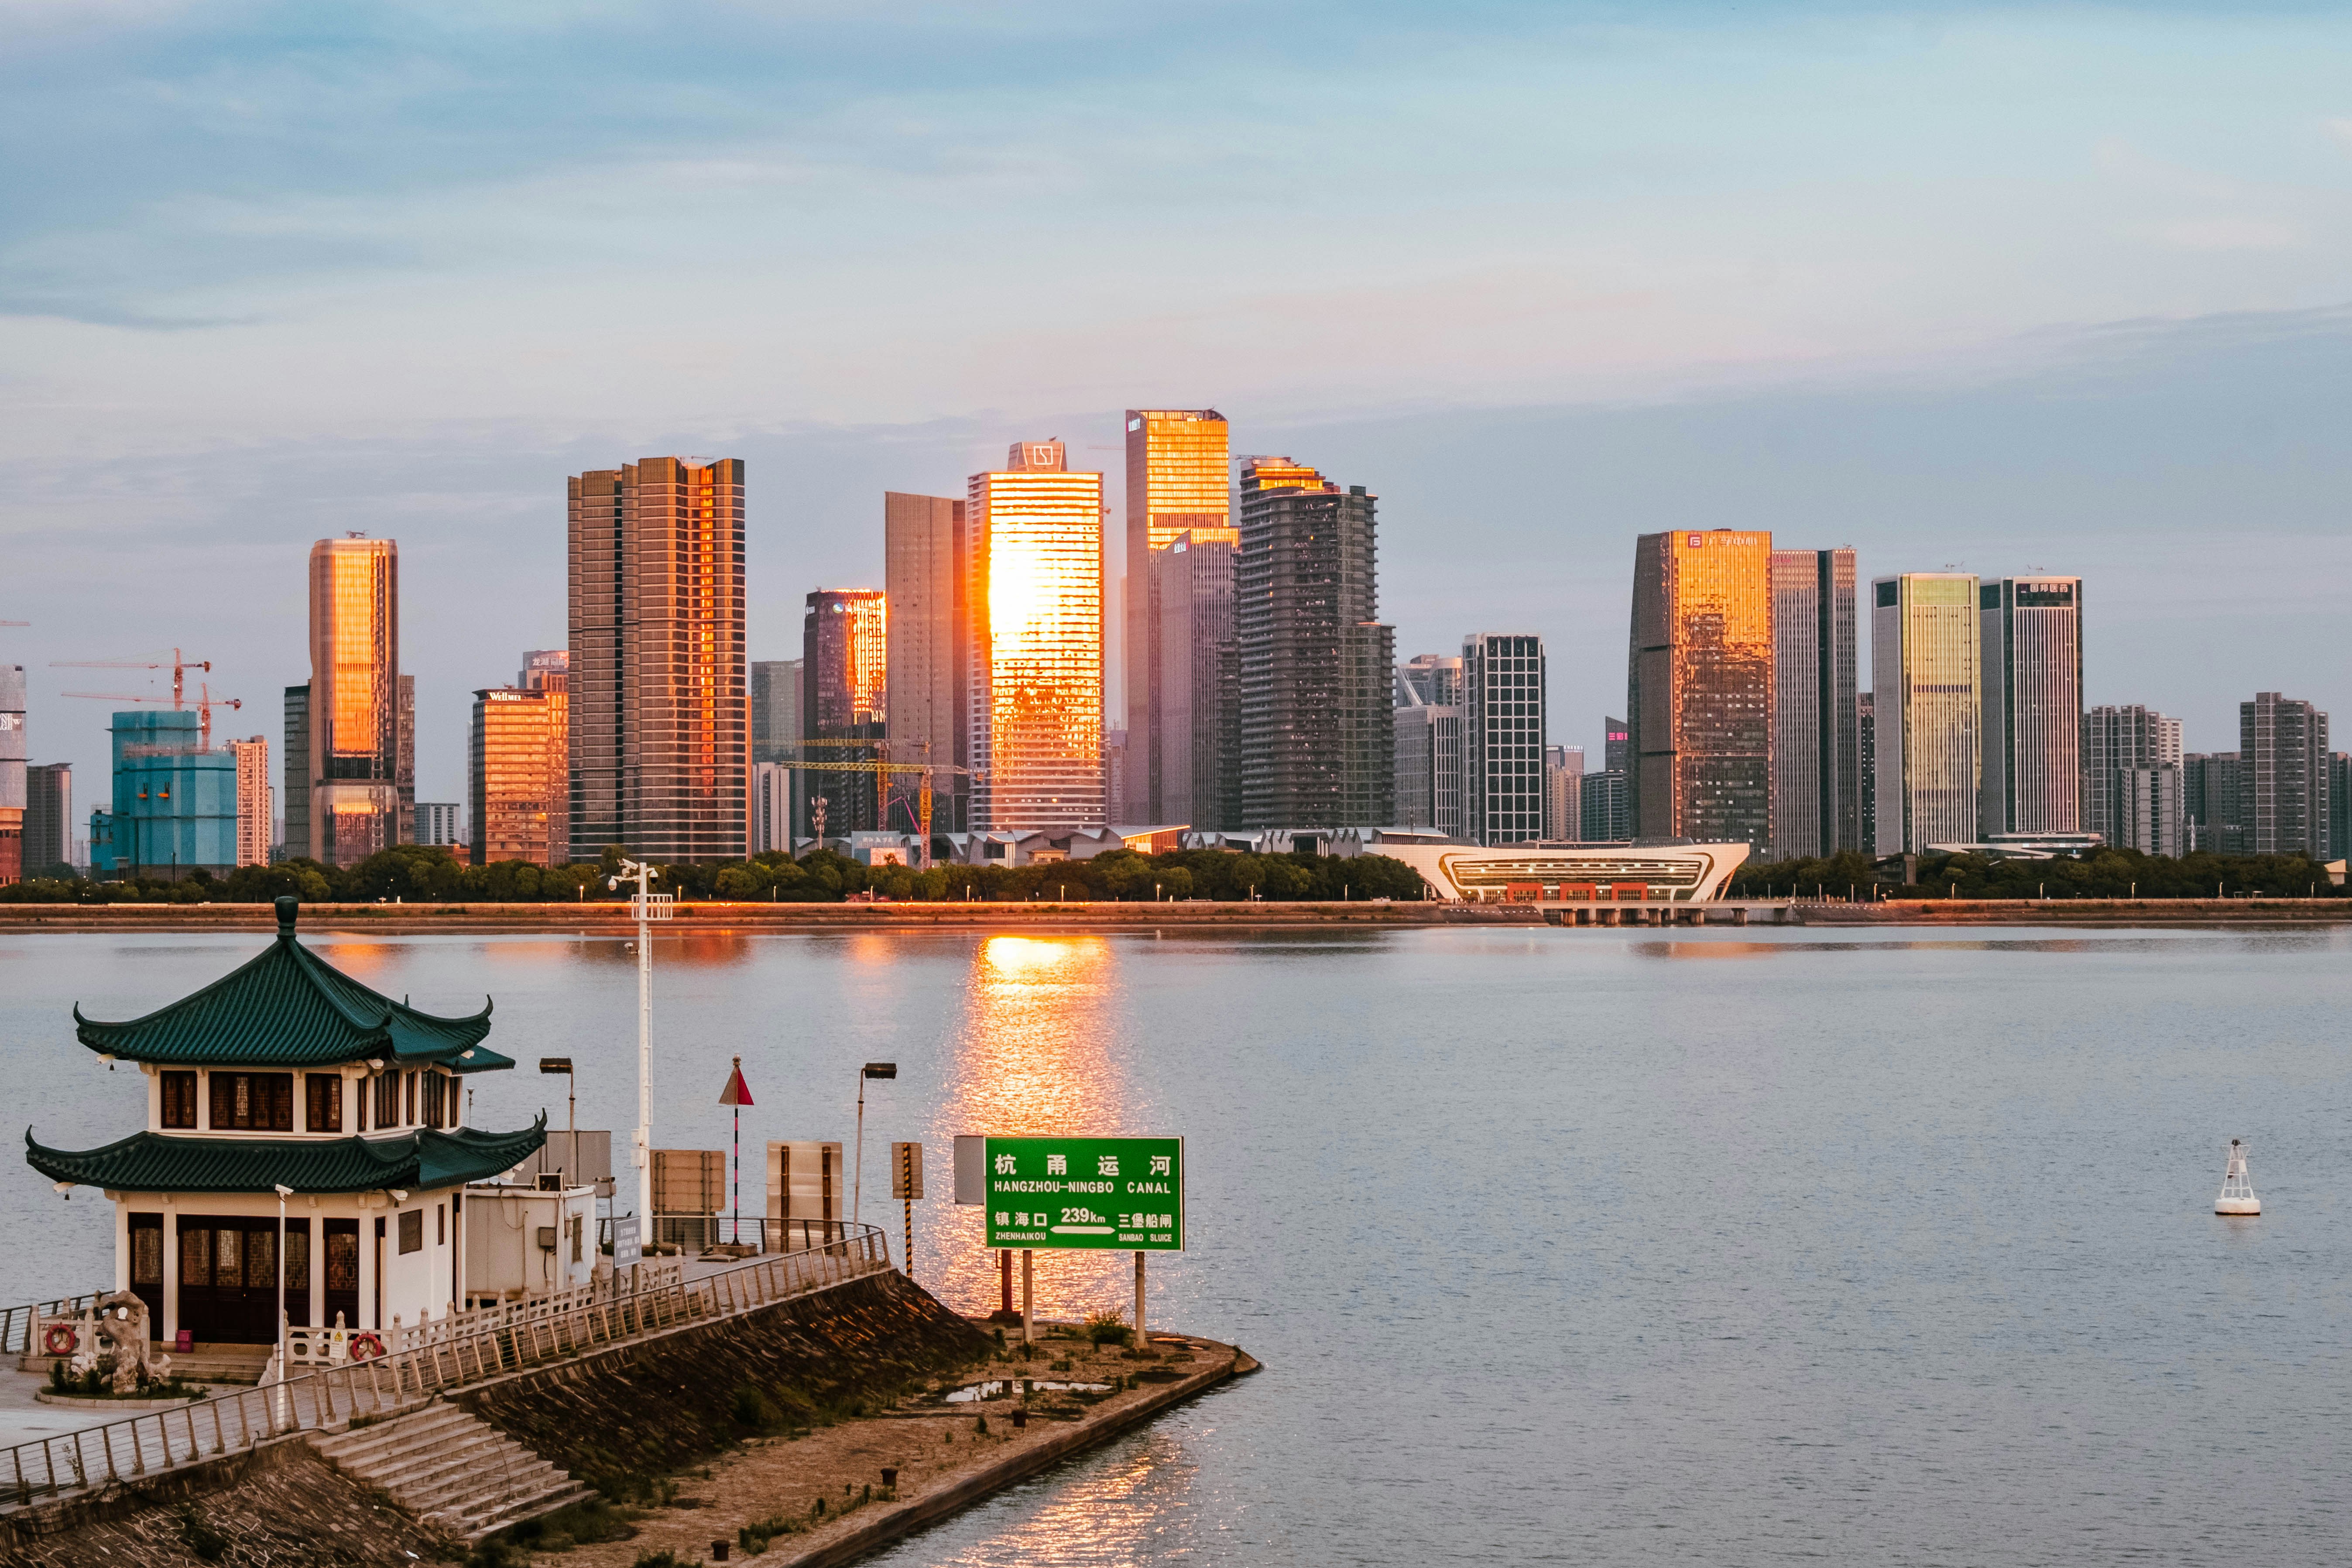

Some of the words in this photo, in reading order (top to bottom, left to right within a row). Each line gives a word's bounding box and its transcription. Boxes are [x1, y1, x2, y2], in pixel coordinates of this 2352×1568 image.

[2030, 583, 2068, 593] 国邦医药
[994, 1153, 1171, 1176] 杭甬运河
[994, 1180, 1114, 1194] HANGZHOU-NINGBO
[1127, 1181, 1171, 1194] CANAL
[994, 1211, 1047, 1227] 镇海口
[1118, 1212, 1172, 1228] 三堡船闸
[995, 1232, 1047, 1241] ZHENHAIKOU
[1118, 1233, 1144, 1242] SANBAO
[1149, 1233, 1173, 1242] SLUICE
